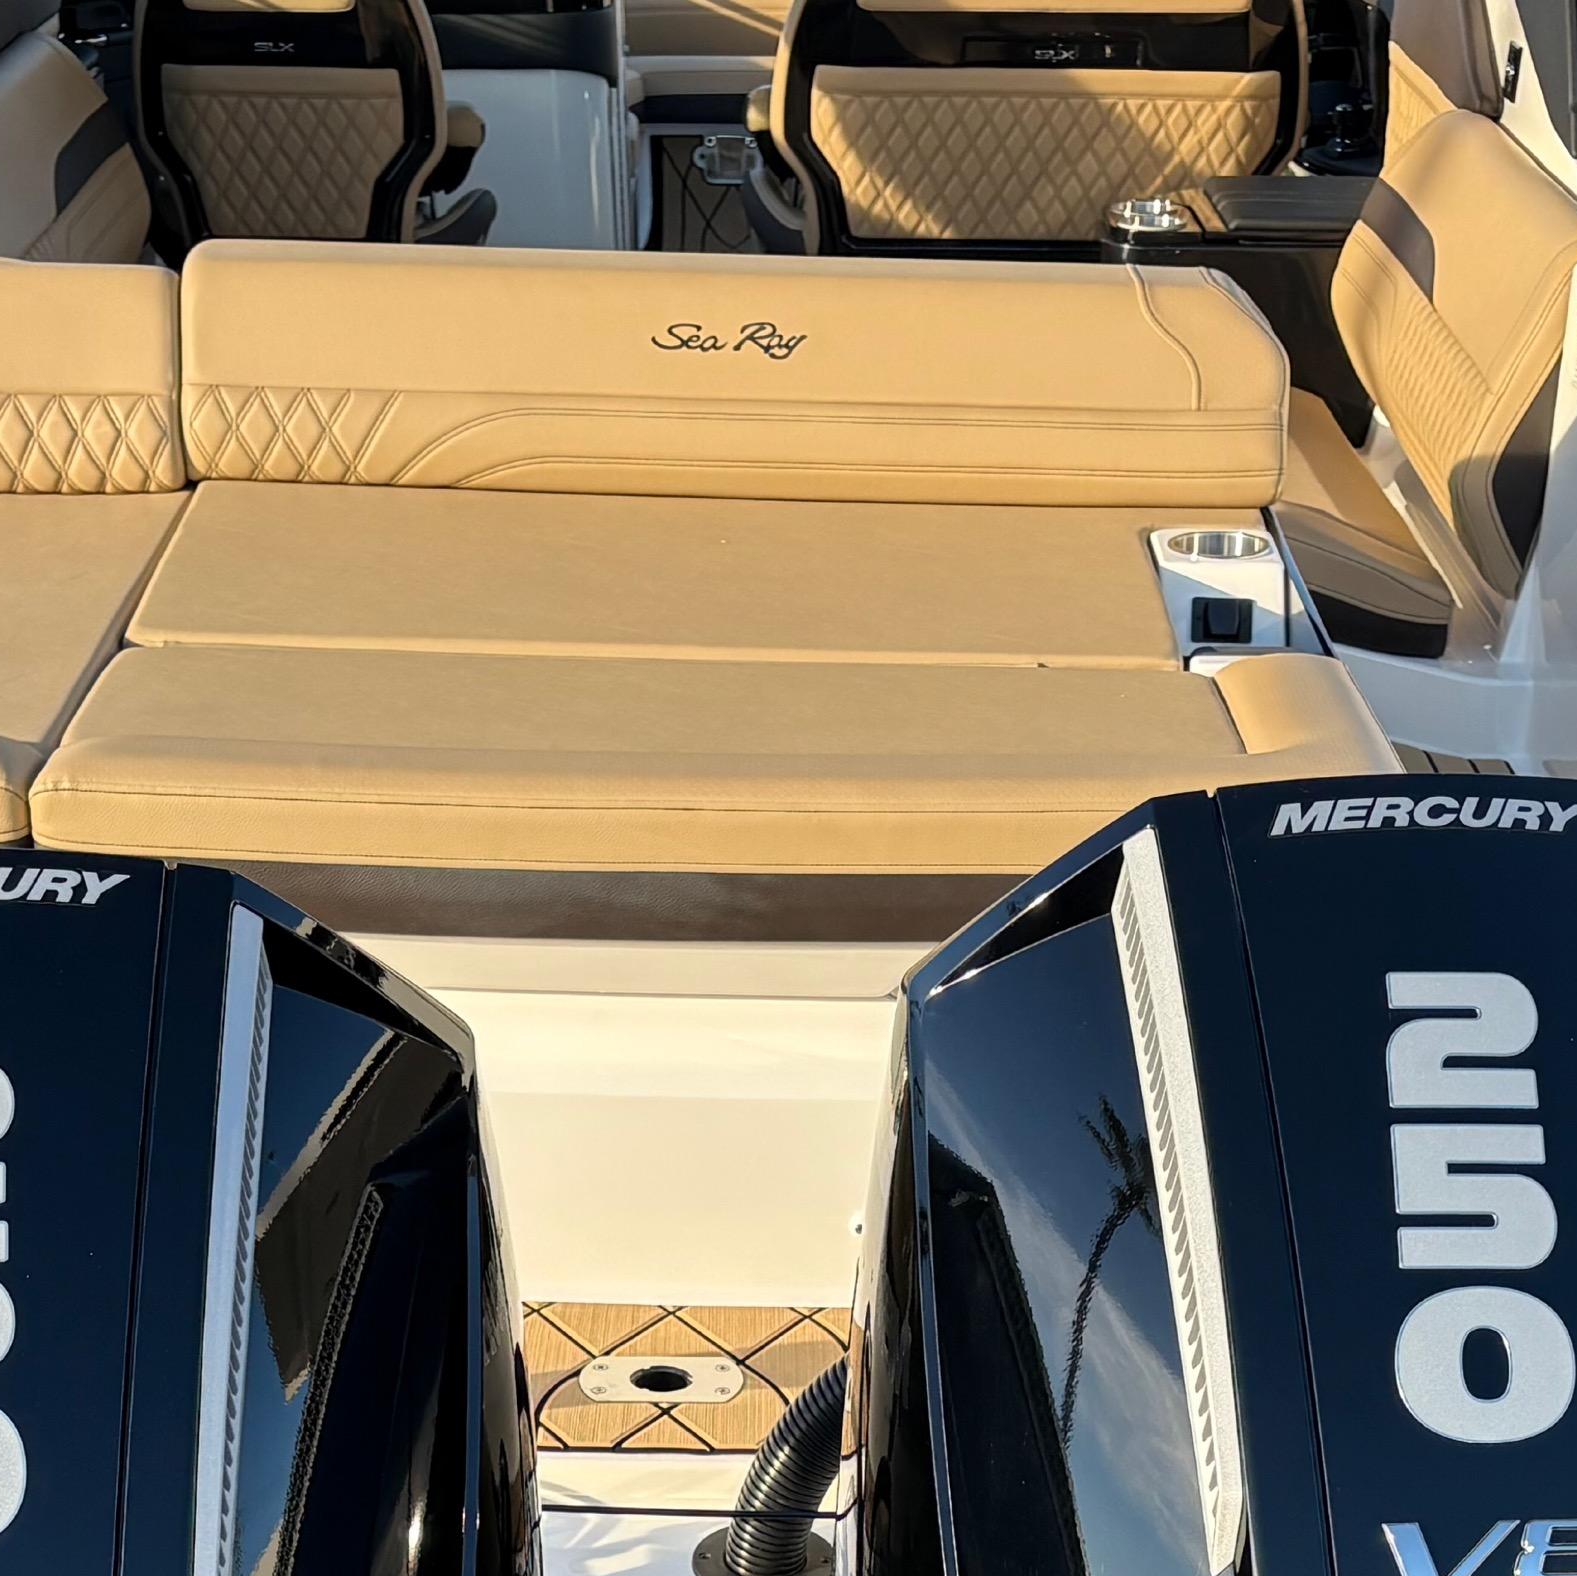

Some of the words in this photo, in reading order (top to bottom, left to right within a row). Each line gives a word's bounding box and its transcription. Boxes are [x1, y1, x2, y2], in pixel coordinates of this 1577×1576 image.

[253, 42, 295, 52] SLX
[651, 323, 728, 352] Sea
[733, 322, 808, 360] Ray
[1386, 971, 1576, 1443] 250
